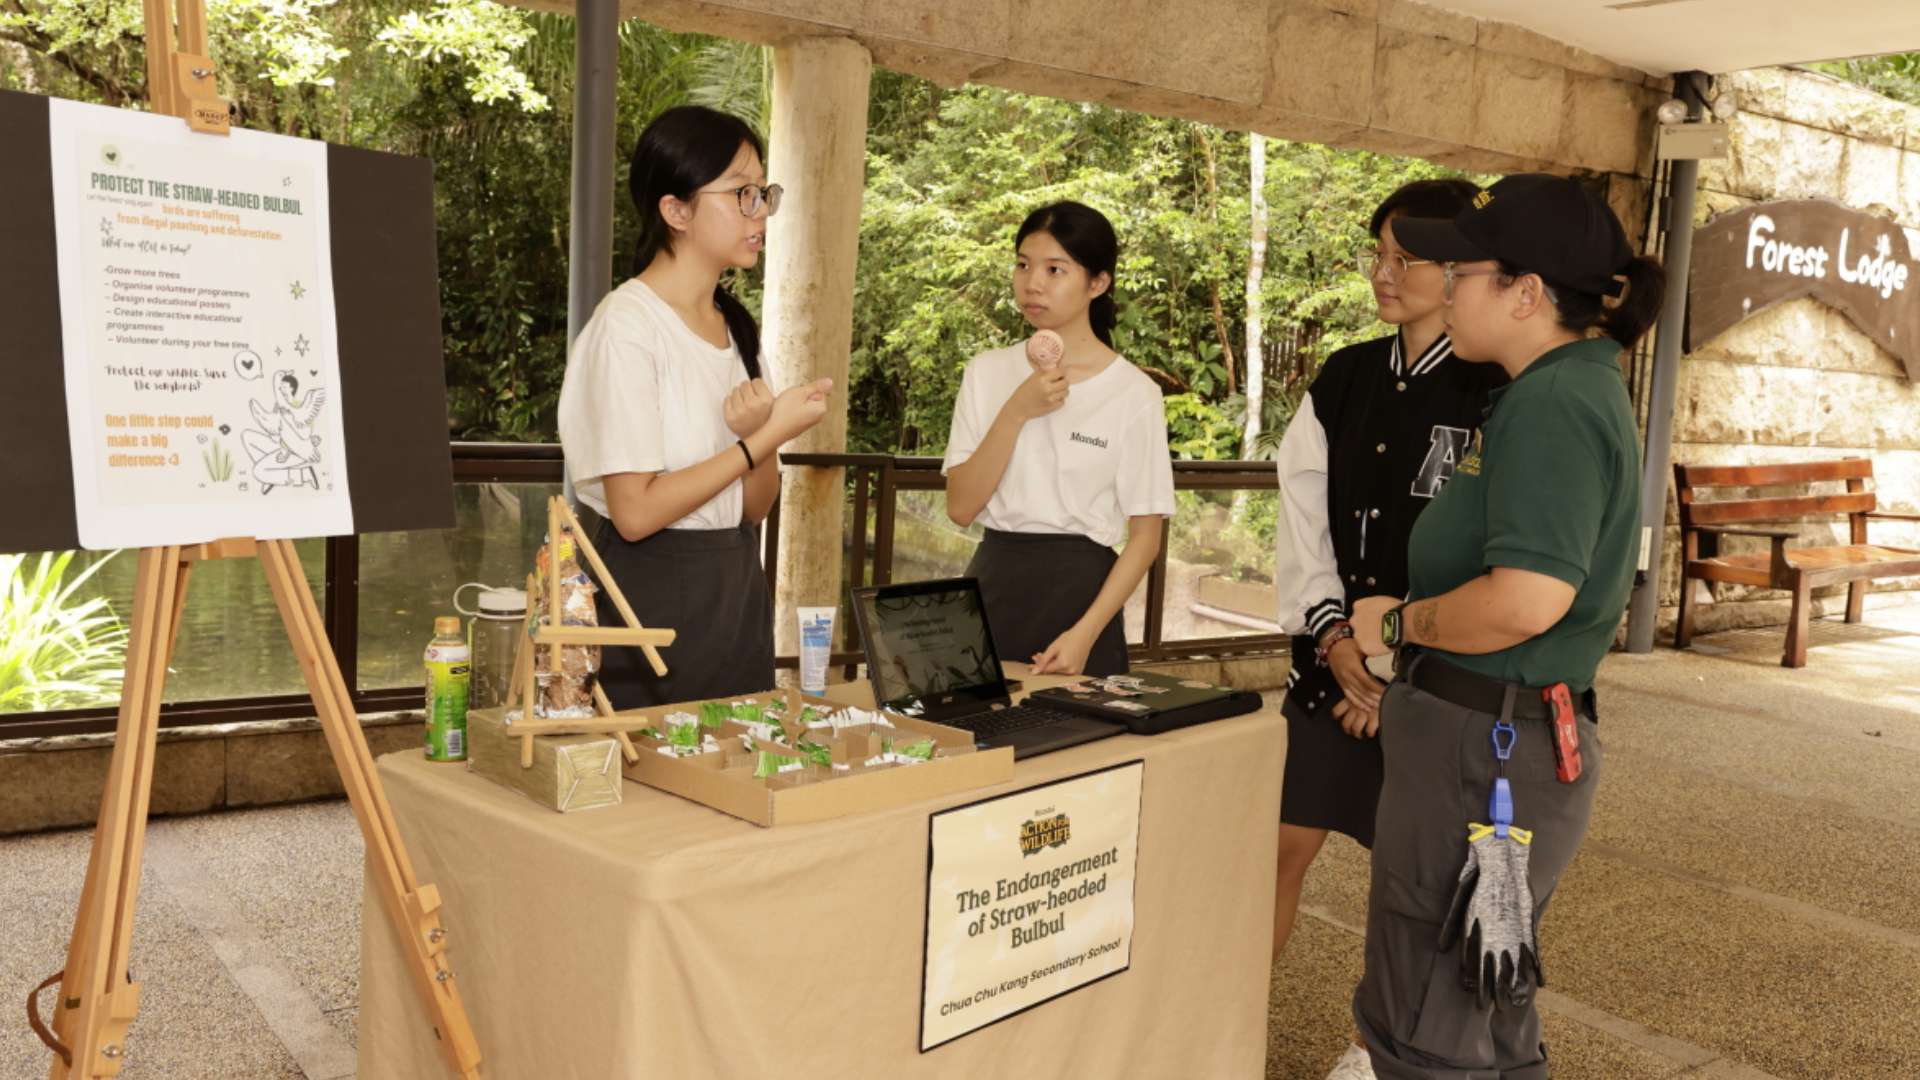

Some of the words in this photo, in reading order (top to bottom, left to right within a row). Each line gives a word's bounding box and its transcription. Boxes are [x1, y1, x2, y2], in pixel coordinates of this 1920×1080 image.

[91, 172, 144, 195] PROTECT
[147, 180, 169, 199] THE
[173, 183, 260, 210] STRAW-HEADED
[263, 195, 303, 215] BULBUL
[162, 203, 184, 215] birds
[186, 208, 200, 218] are
[202, 209, 240, 225] suffering
[116, 213, 140, 225] from
[142, 215, 168, 230] illegal
[170, 219, 208, 235] poaching
[210, 224, 226, 235] and
[227, 226, 282, 241] deforestation
[1746, 214, 1829, 279] Forest
[1838, 227, 1908, 299] Lodge
[133, 268, 156, 278] more
[158, 270, 181, 280] trees
[112, 280, 153, 292] Organise
[155, 282, 197, 294] volunteer
[198, 287, 250, 299] programmes
[112, 293, 145, 305] Design
[147, 296, 198, 308] educational
[199, 300, 231, 310] posters
[114, 307, 144, 317] Create
[145, 308, 192, 320] interactive
[193, 312, 243, 323] educational
[106, 320, 164, 332] programmes
[116, 335, 160, 345] Volunteer
[161, 337, 190, 349] during
[192, 339, 211, 349] your
[213, 339, 230, 348] free
[231, 340, 250, 349] time
[148, 368, 164, 378] our
[204, 367, 227, 379] Save
[134, 379, 151, 391] the
[105, 413, 127, 428] One
[129, 413, 155, 428] little
[157, 414, 182, 429] step
[184, 414, 214, 428] could
[106, 433, 138, 448] make
[141, 435, 148, 447] a
[150, 433, 168, 449] big
[1069, 431, 1109, 449] Mandai
[109, 453, 166, 467] difference
[168, 453, 179, 466] <3
[1410, 424, 1470, 498] A
[1021, 816, 1058, 838] ACTION
[1018, 827, 1071, 852] WILDLIFE
[956, 888, 991, 914] The
[995, 847, 1118, 902] Endangerment
[967, 912, 986, 938] of
[990, 873, 1107, 931] Straw-headed
[1010, 911, 1066, 949] Bulbul
[940, 995, 973, 1017] Chua
[974, 984, 998, 1004] Chu
[999, 973, 1029, 995] Kang
[1030, 950, 1087, 983] Secondary
[1087, 937, 1122, 960] School
